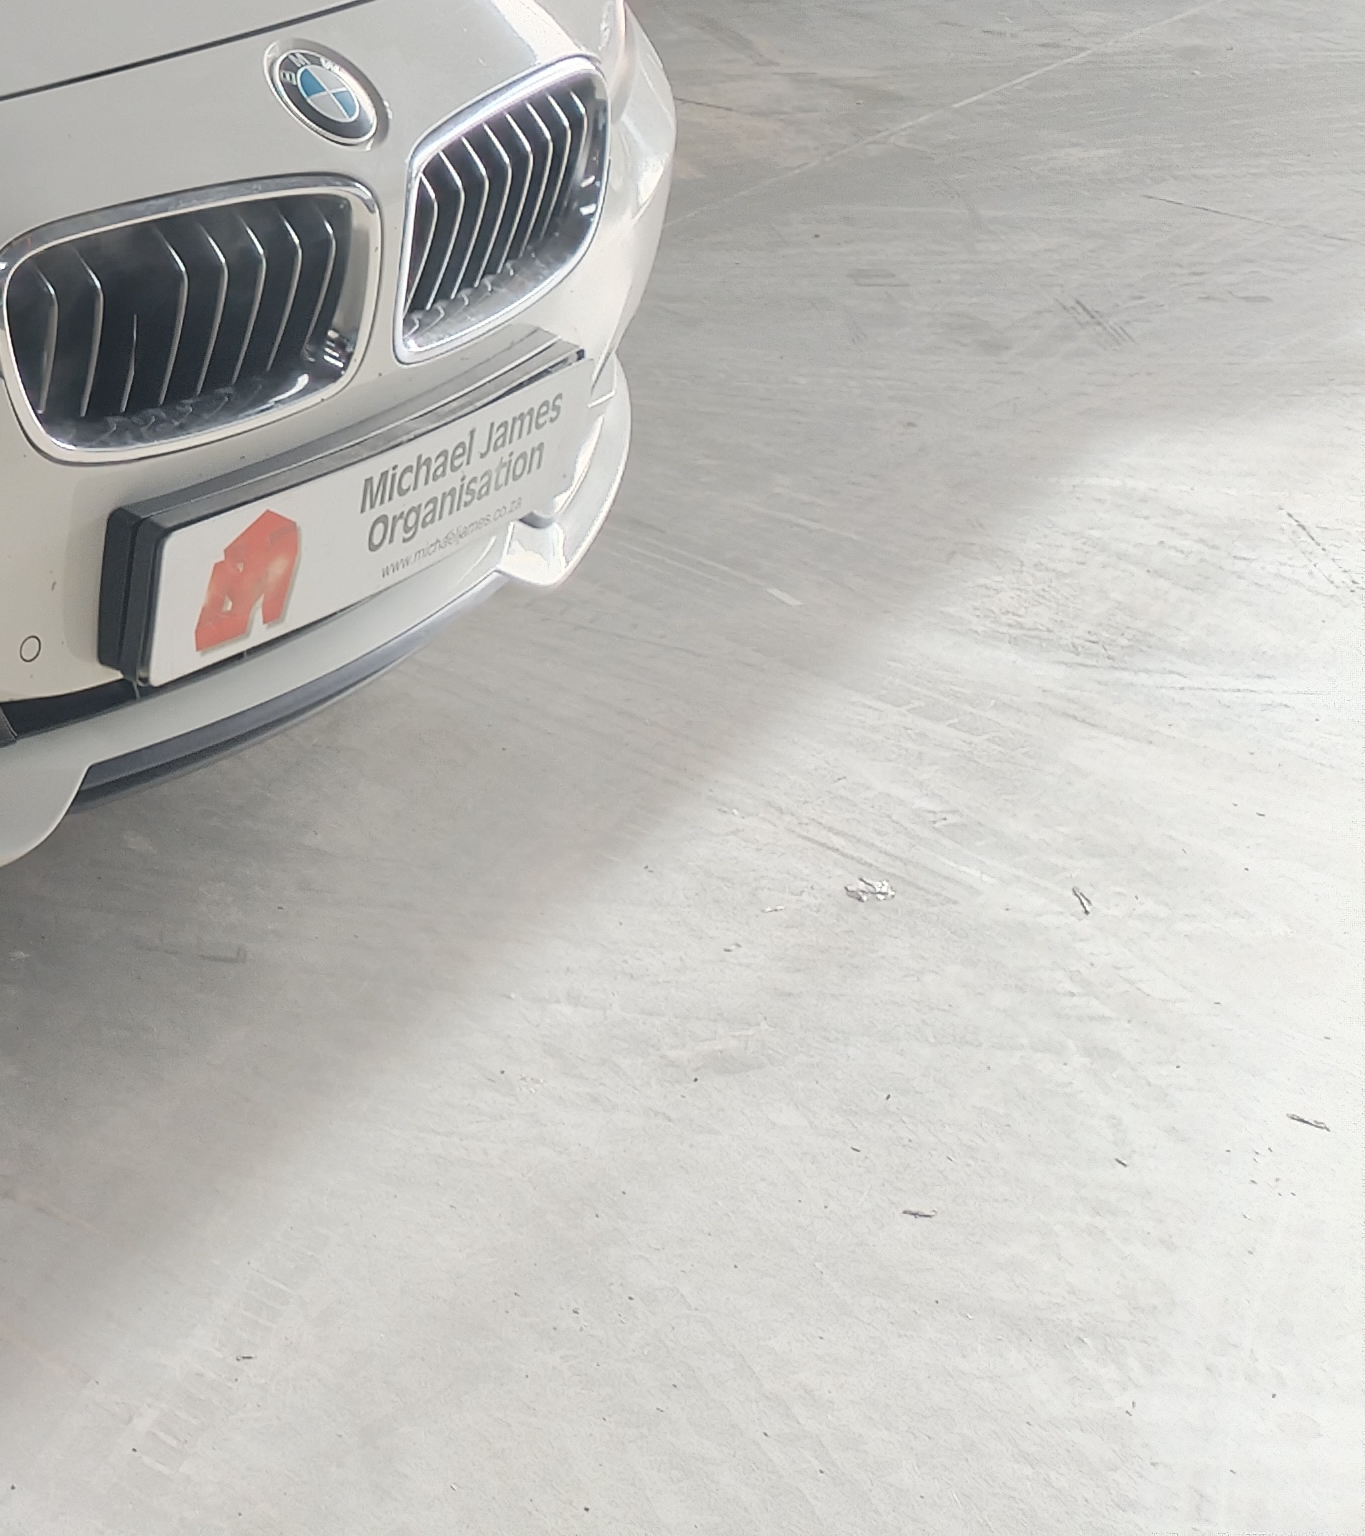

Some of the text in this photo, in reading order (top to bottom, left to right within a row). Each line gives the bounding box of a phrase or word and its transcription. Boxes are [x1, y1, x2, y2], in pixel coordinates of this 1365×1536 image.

[360, 392, 563, 514] Michael James
[368, 441, 545, 553] Organisation
